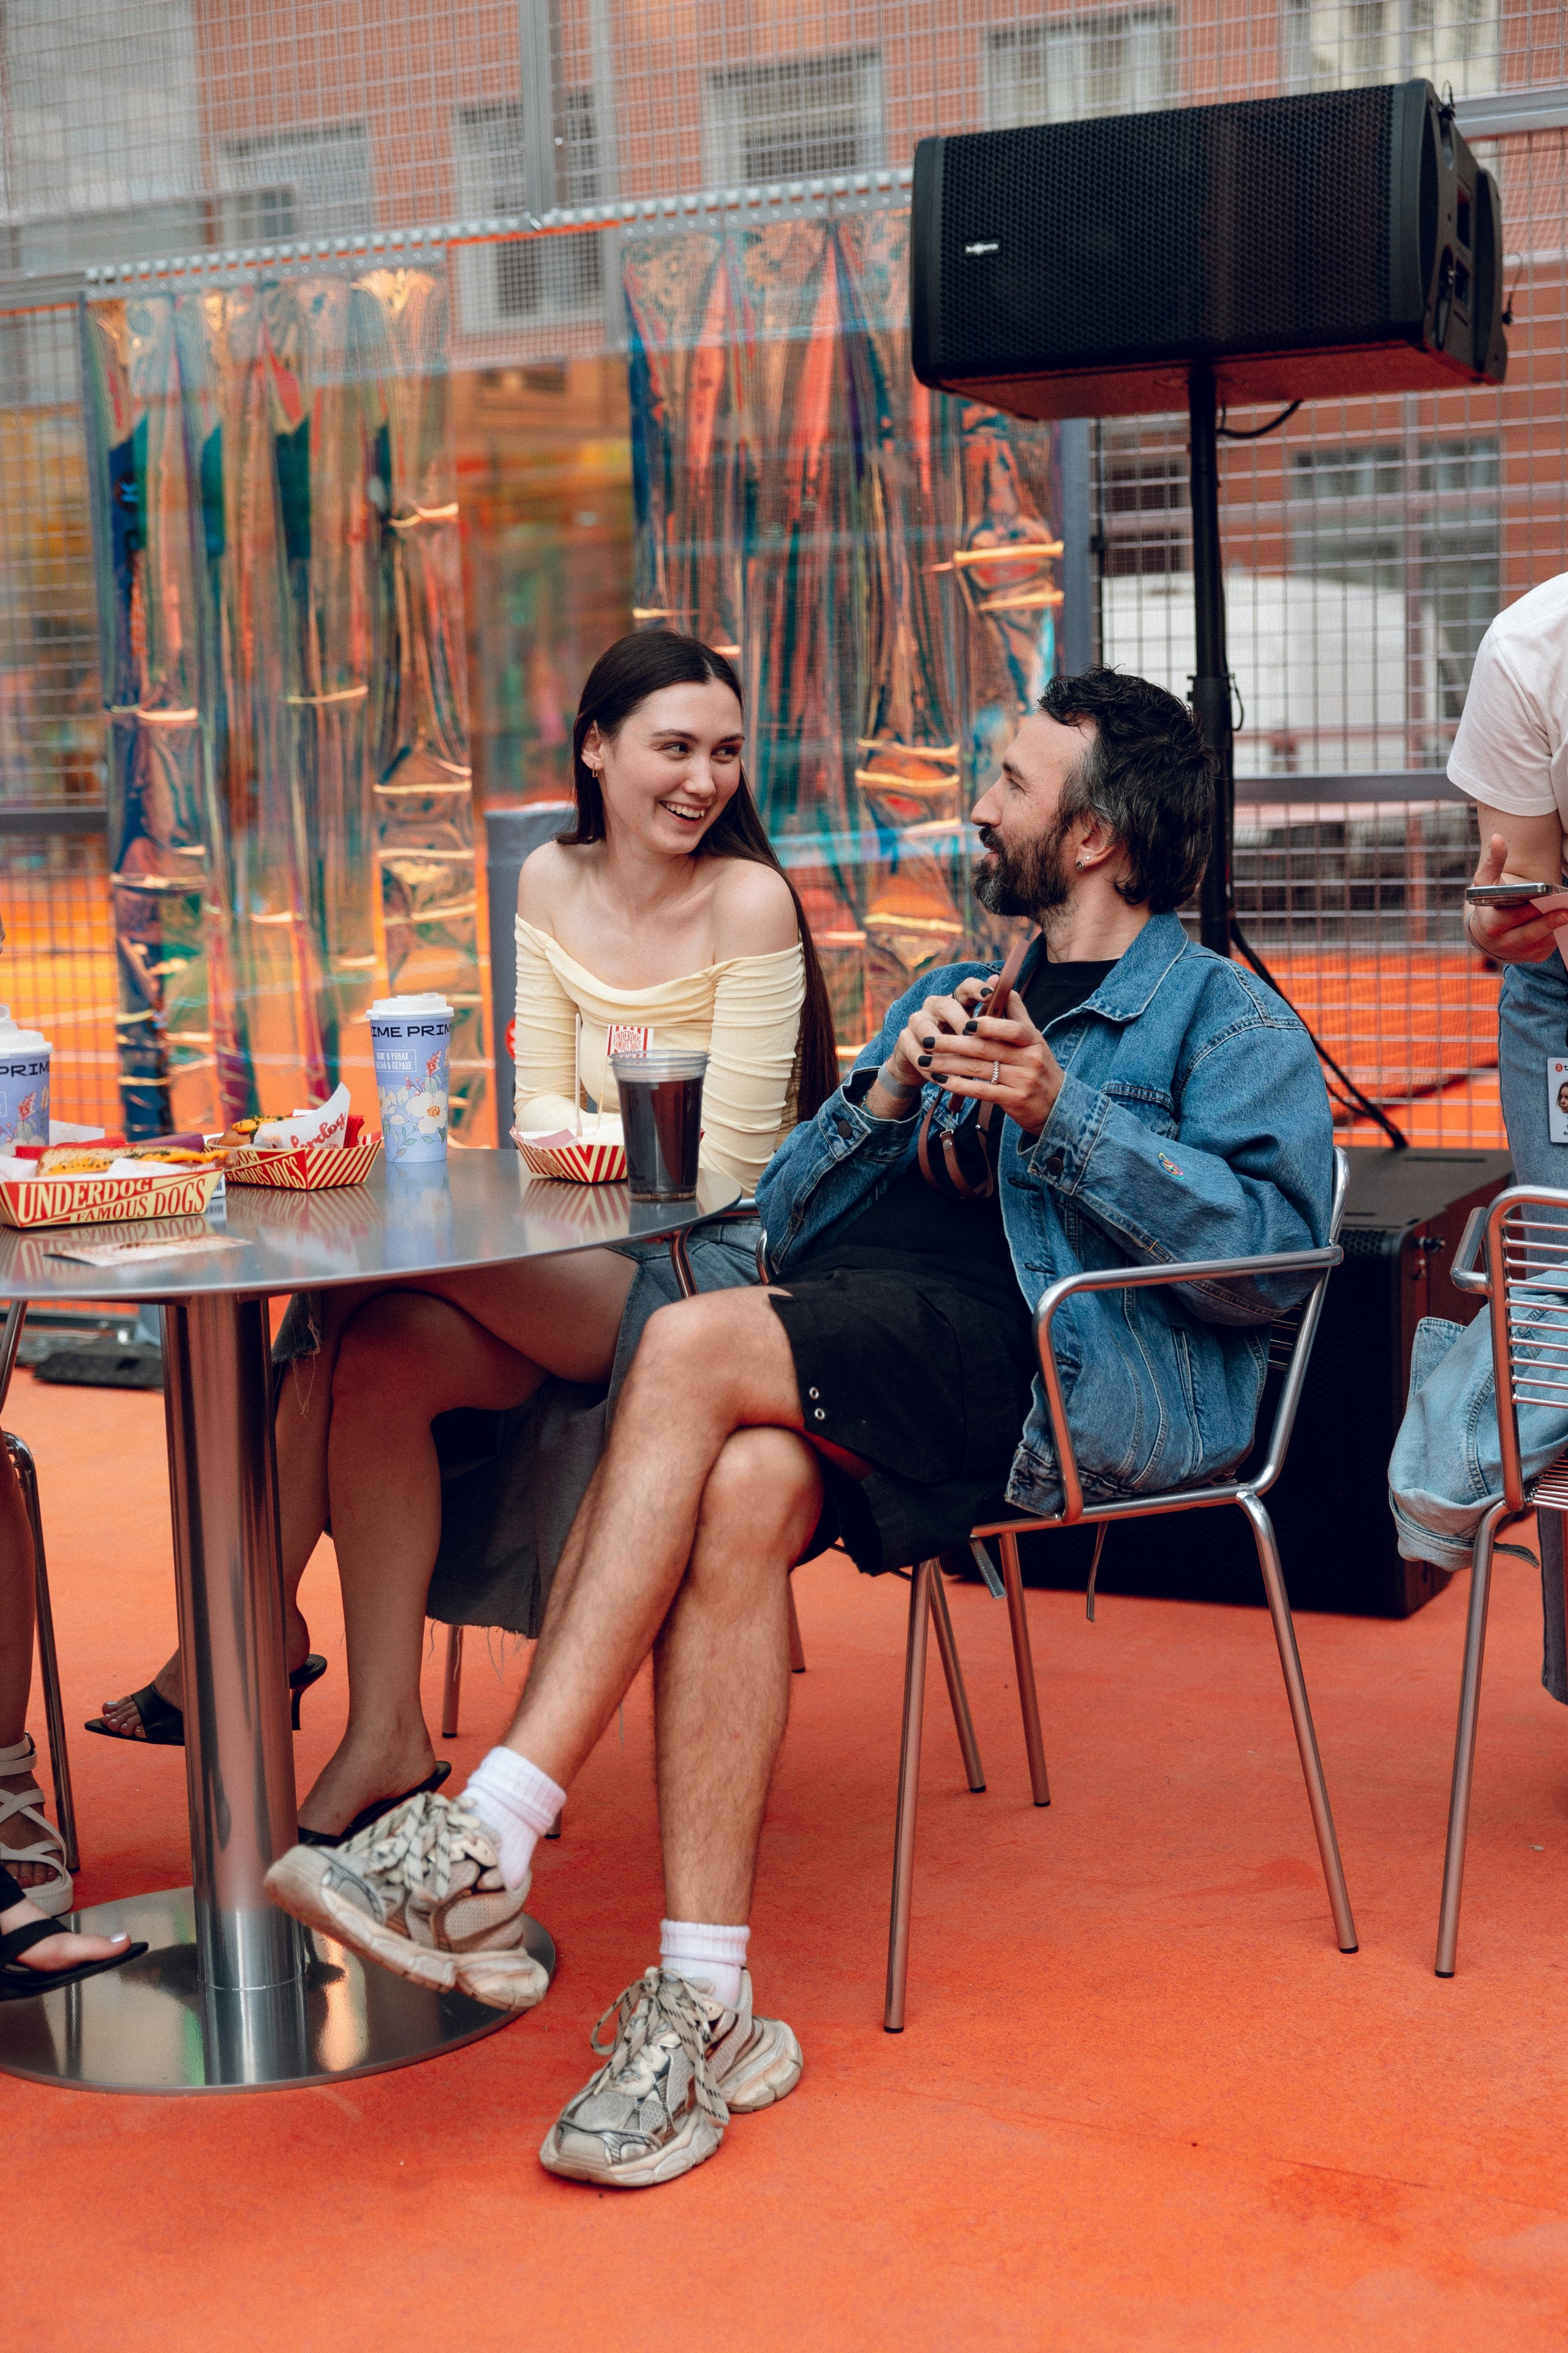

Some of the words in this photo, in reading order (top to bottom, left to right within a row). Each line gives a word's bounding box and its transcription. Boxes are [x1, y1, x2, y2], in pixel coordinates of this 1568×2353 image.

[371, 1026, 402, 1038] IME
[614, 1031, 641, 1043] UNDERDOG
[630, 1042, 641, 1052] DOGS
[392, 1061, 412, 1070] СЕРДЦЕ
[227, 1164, 271, 1185] FAMOUS
[266, 1156, 307, 1189] DOGS
[18, 1179, 151, 1223] UNDERDOG
[76, 1196, 148, 1222] FAMOUS
[154, 1178, 206, 1216] DOGS
